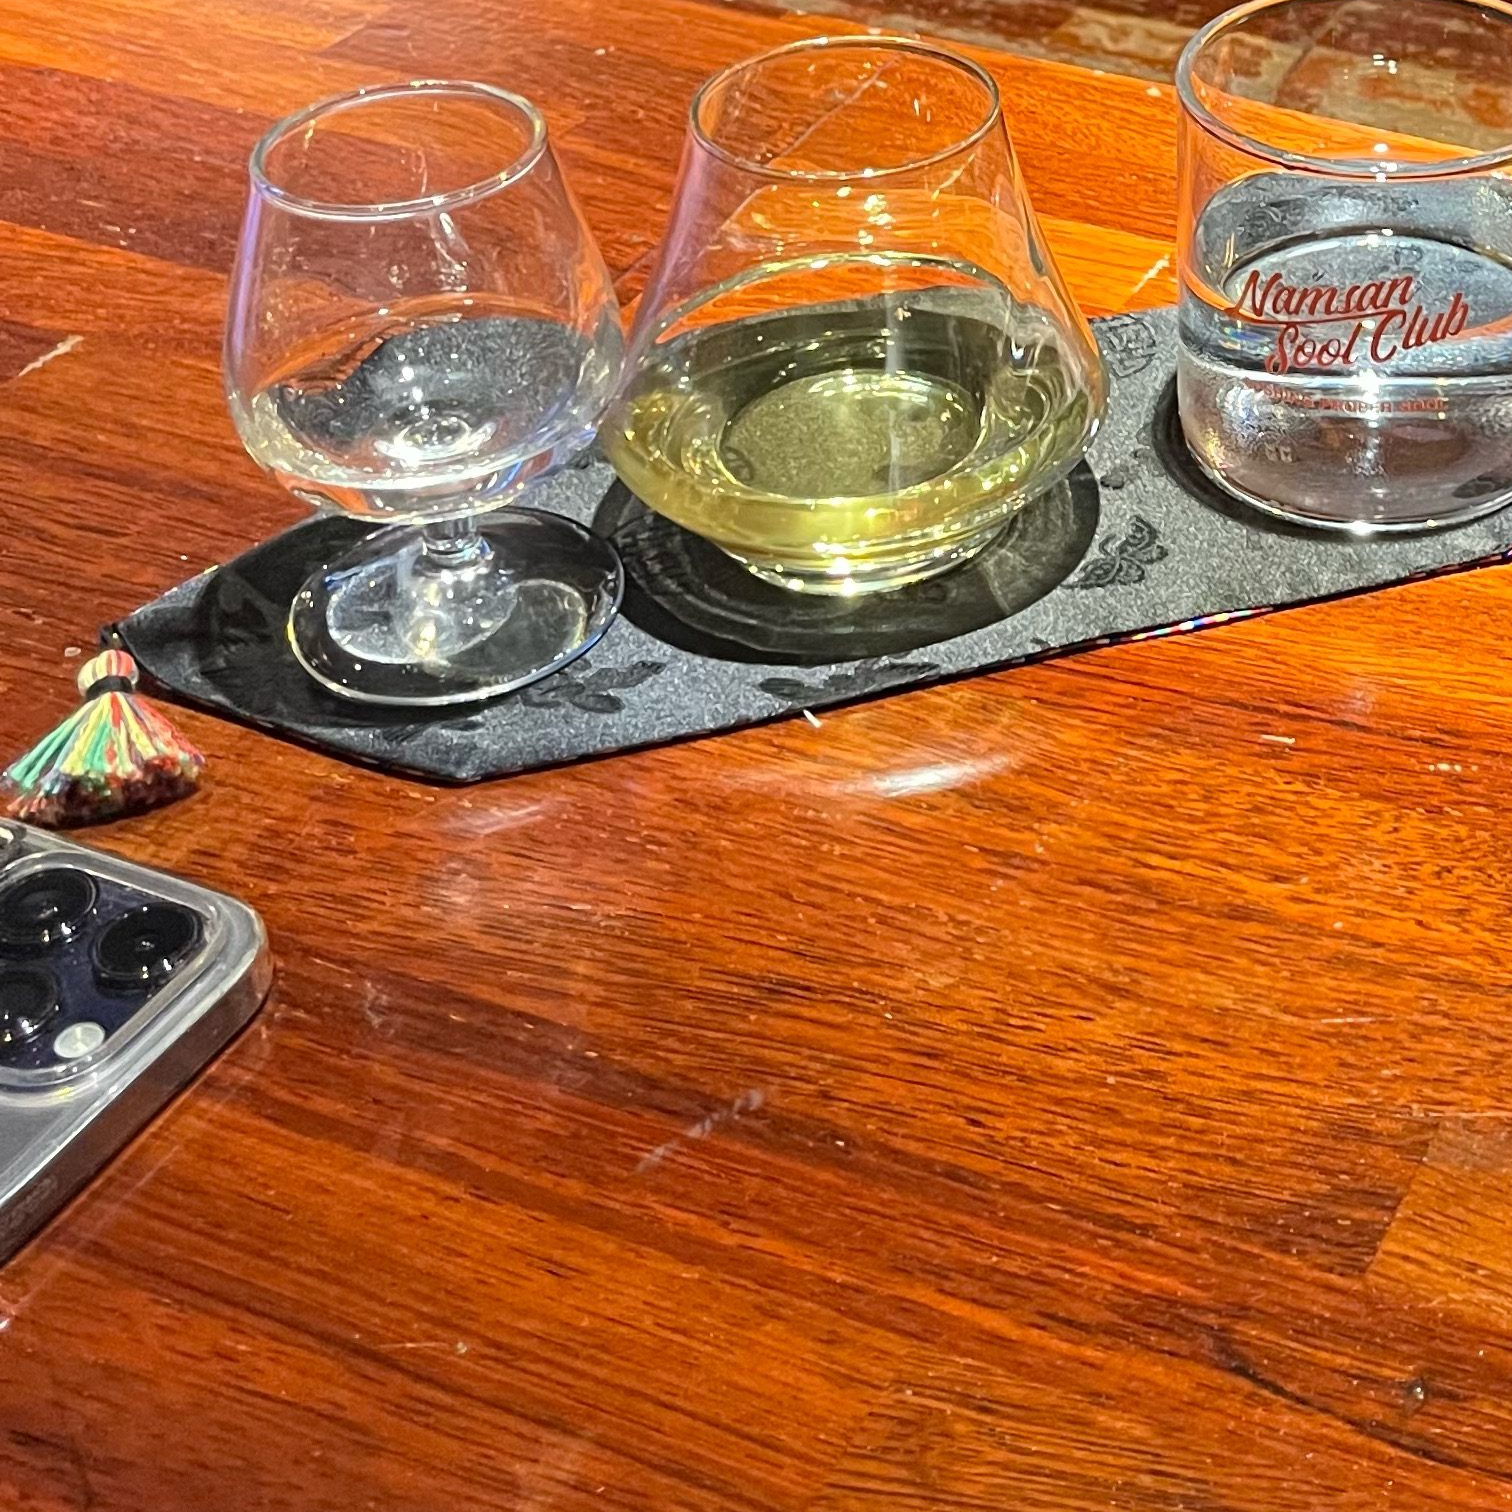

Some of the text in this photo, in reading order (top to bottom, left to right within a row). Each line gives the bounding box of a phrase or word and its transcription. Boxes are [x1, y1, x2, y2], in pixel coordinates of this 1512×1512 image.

[1224, 269, 1415, 318] Namsan
[1264, 291, 1470, 375] Sool Club
